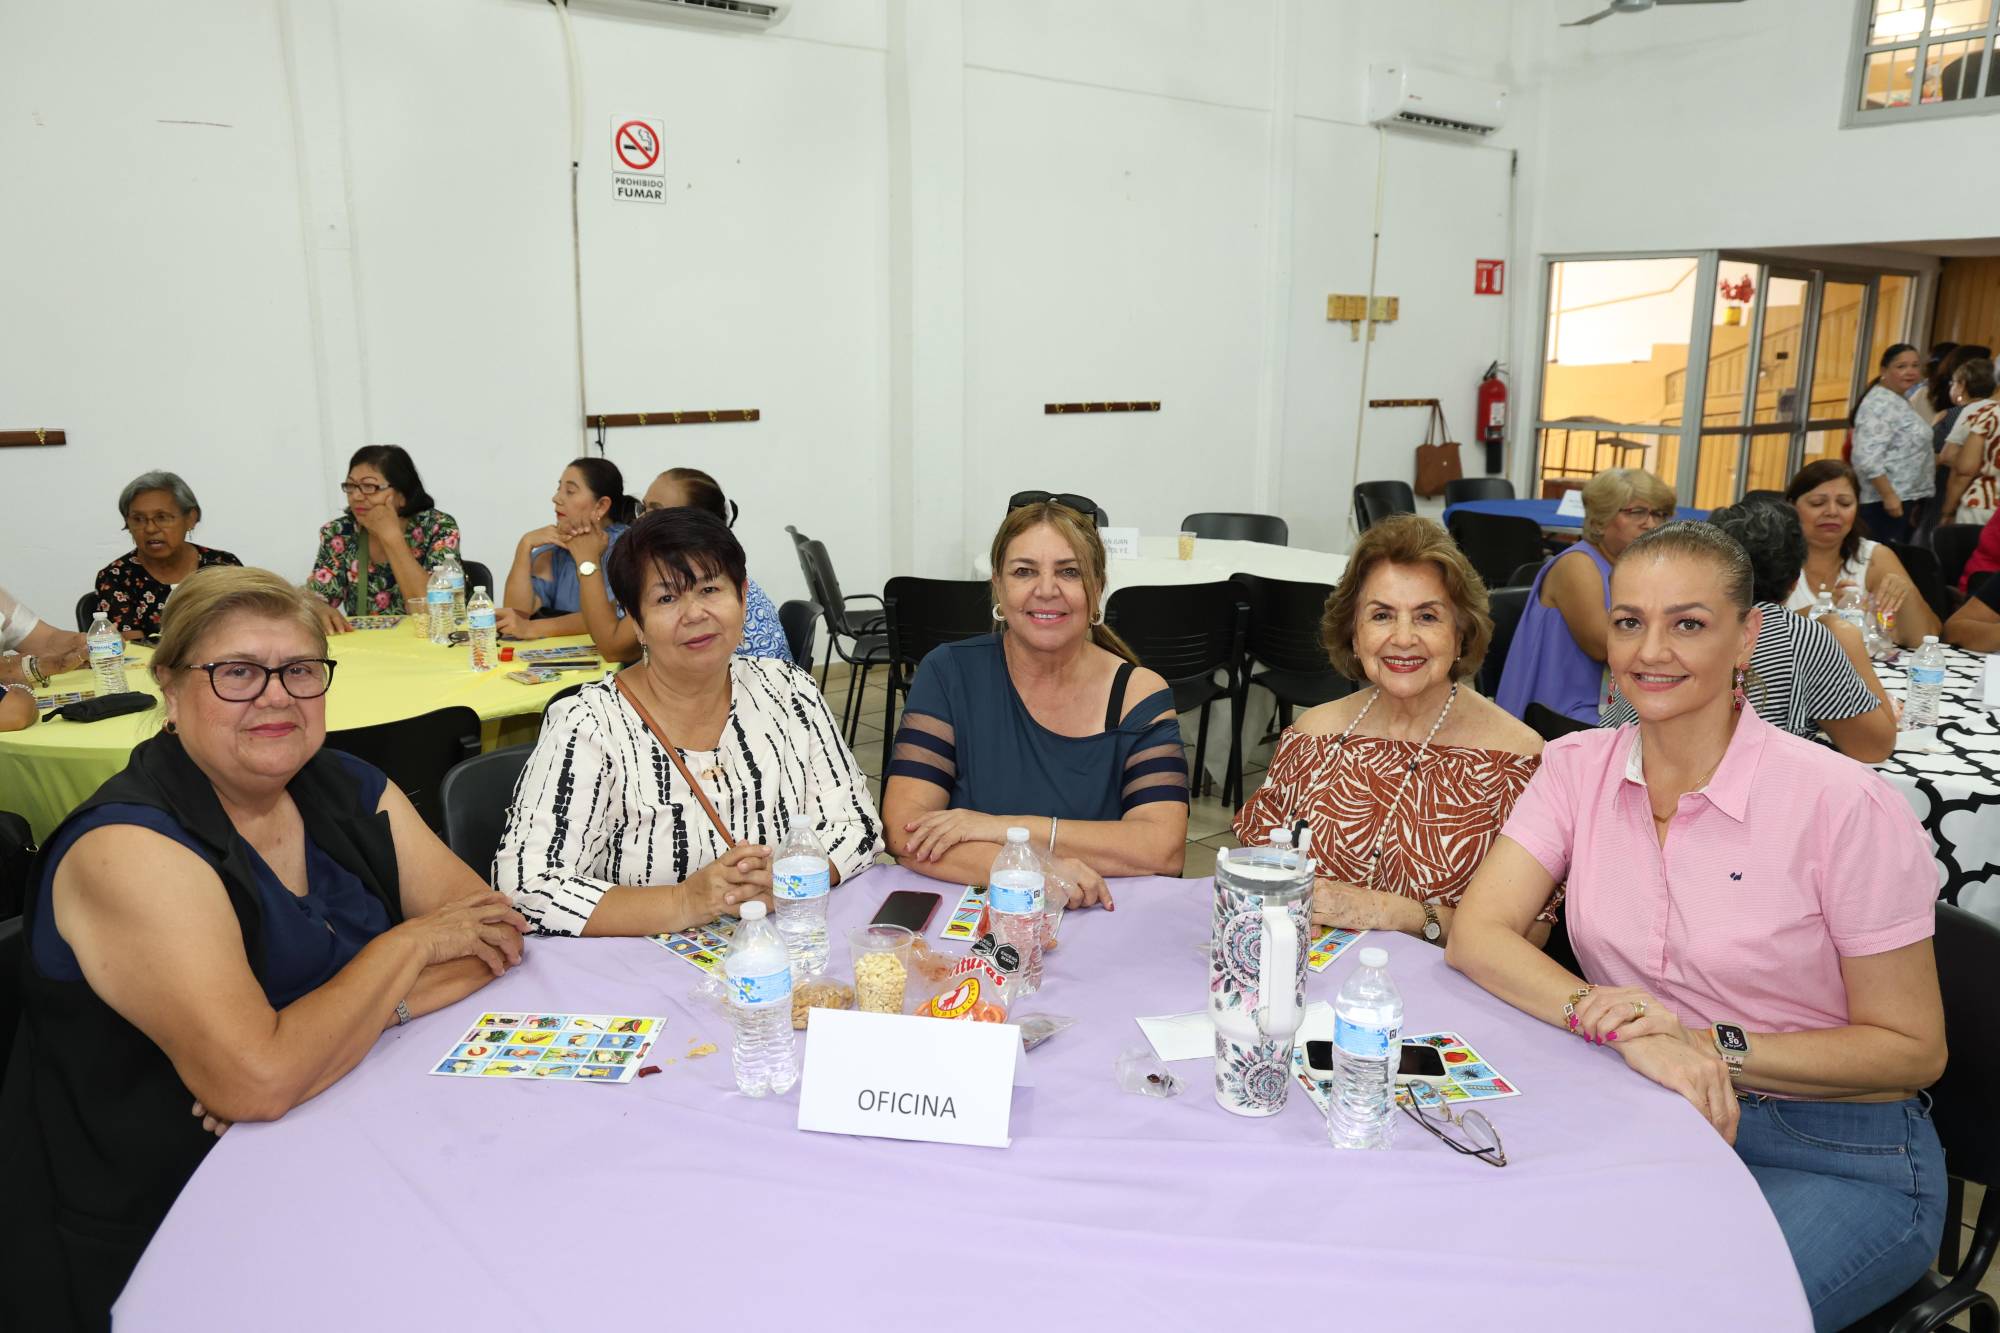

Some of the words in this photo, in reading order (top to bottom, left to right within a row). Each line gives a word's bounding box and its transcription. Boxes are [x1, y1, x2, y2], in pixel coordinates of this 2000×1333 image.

[615, 177, 664, 188] PROHIBIDO
[617, 187, 662, 199] FUMAR
[857, 1089, 956, 1119] OFICINA
